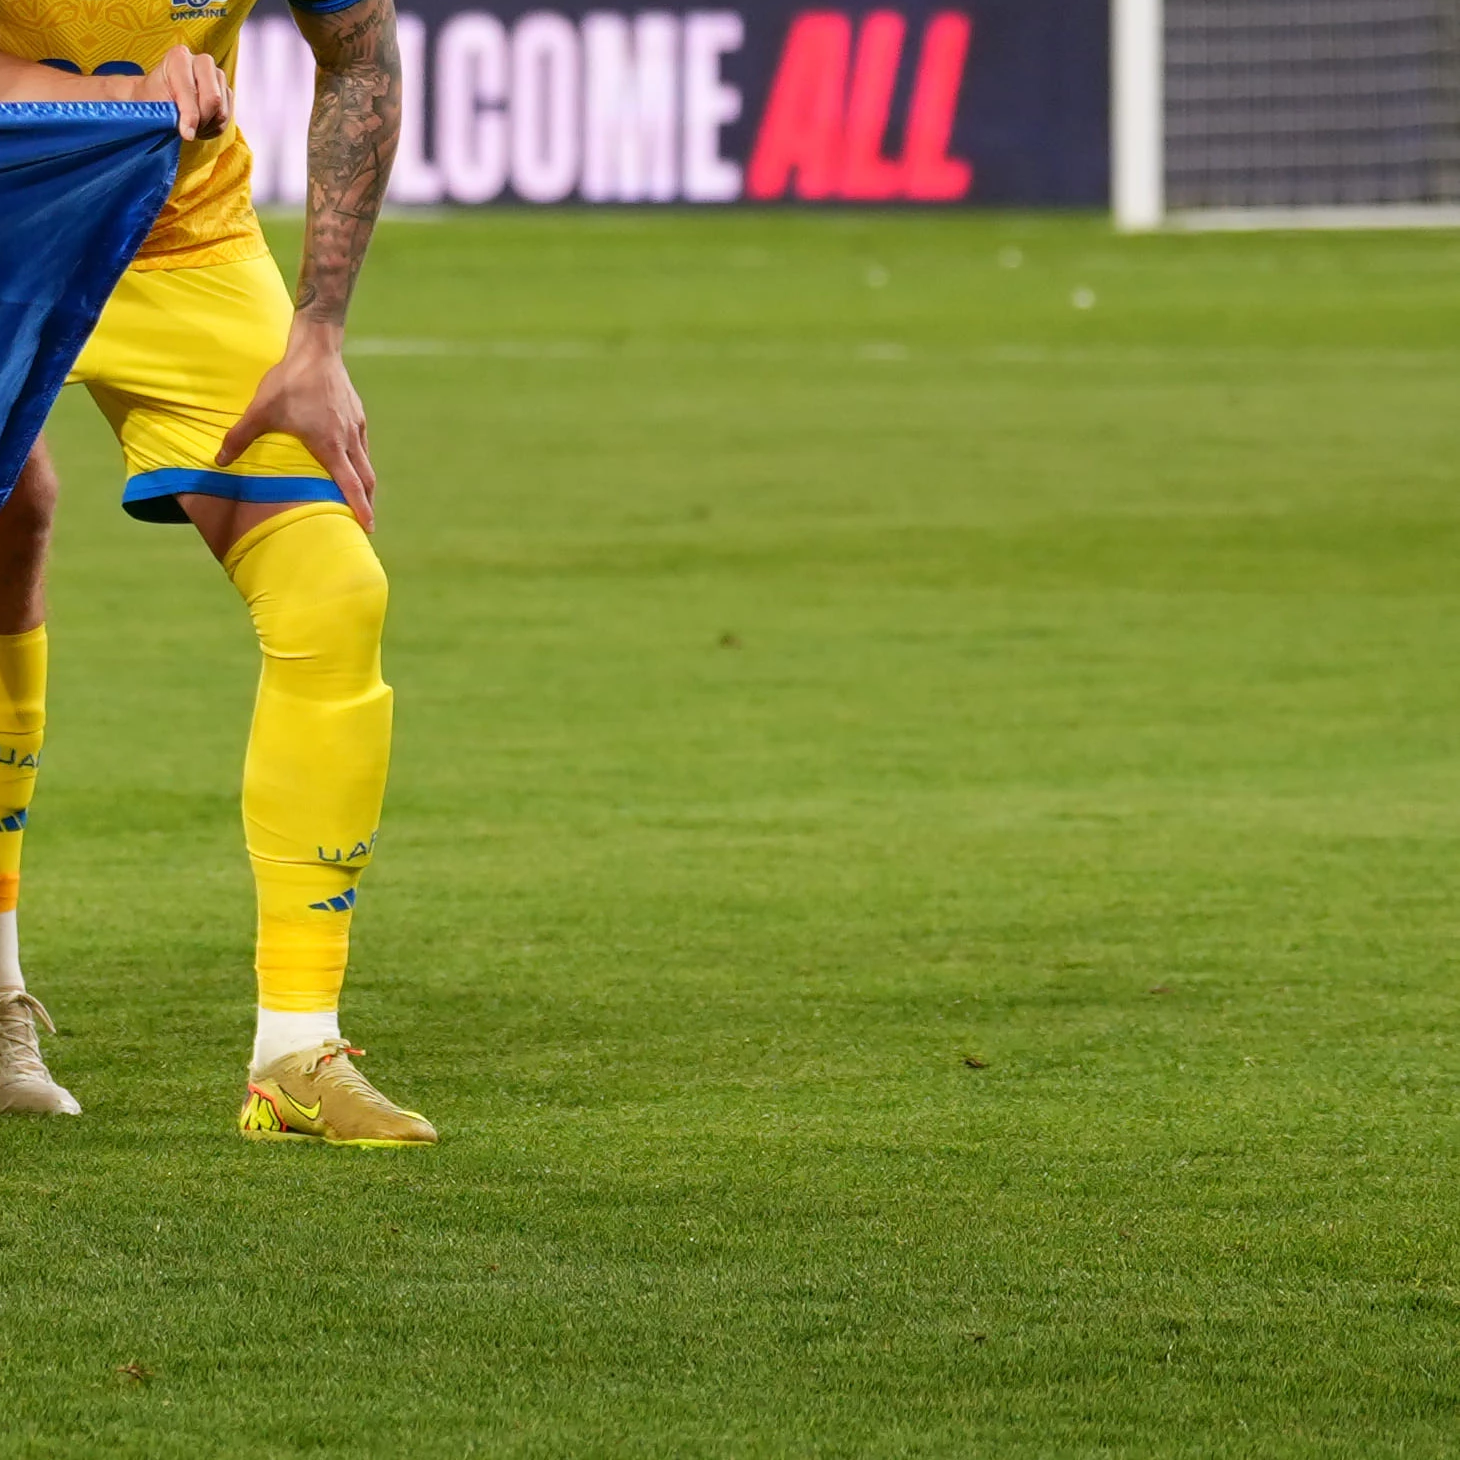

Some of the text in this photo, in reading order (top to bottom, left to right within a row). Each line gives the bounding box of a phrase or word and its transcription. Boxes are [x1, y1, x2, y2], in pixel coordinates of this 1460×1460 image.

[170, 7, 229, 21] UKRAINE
[237, 7, 974, 204] WLCOME ALL
